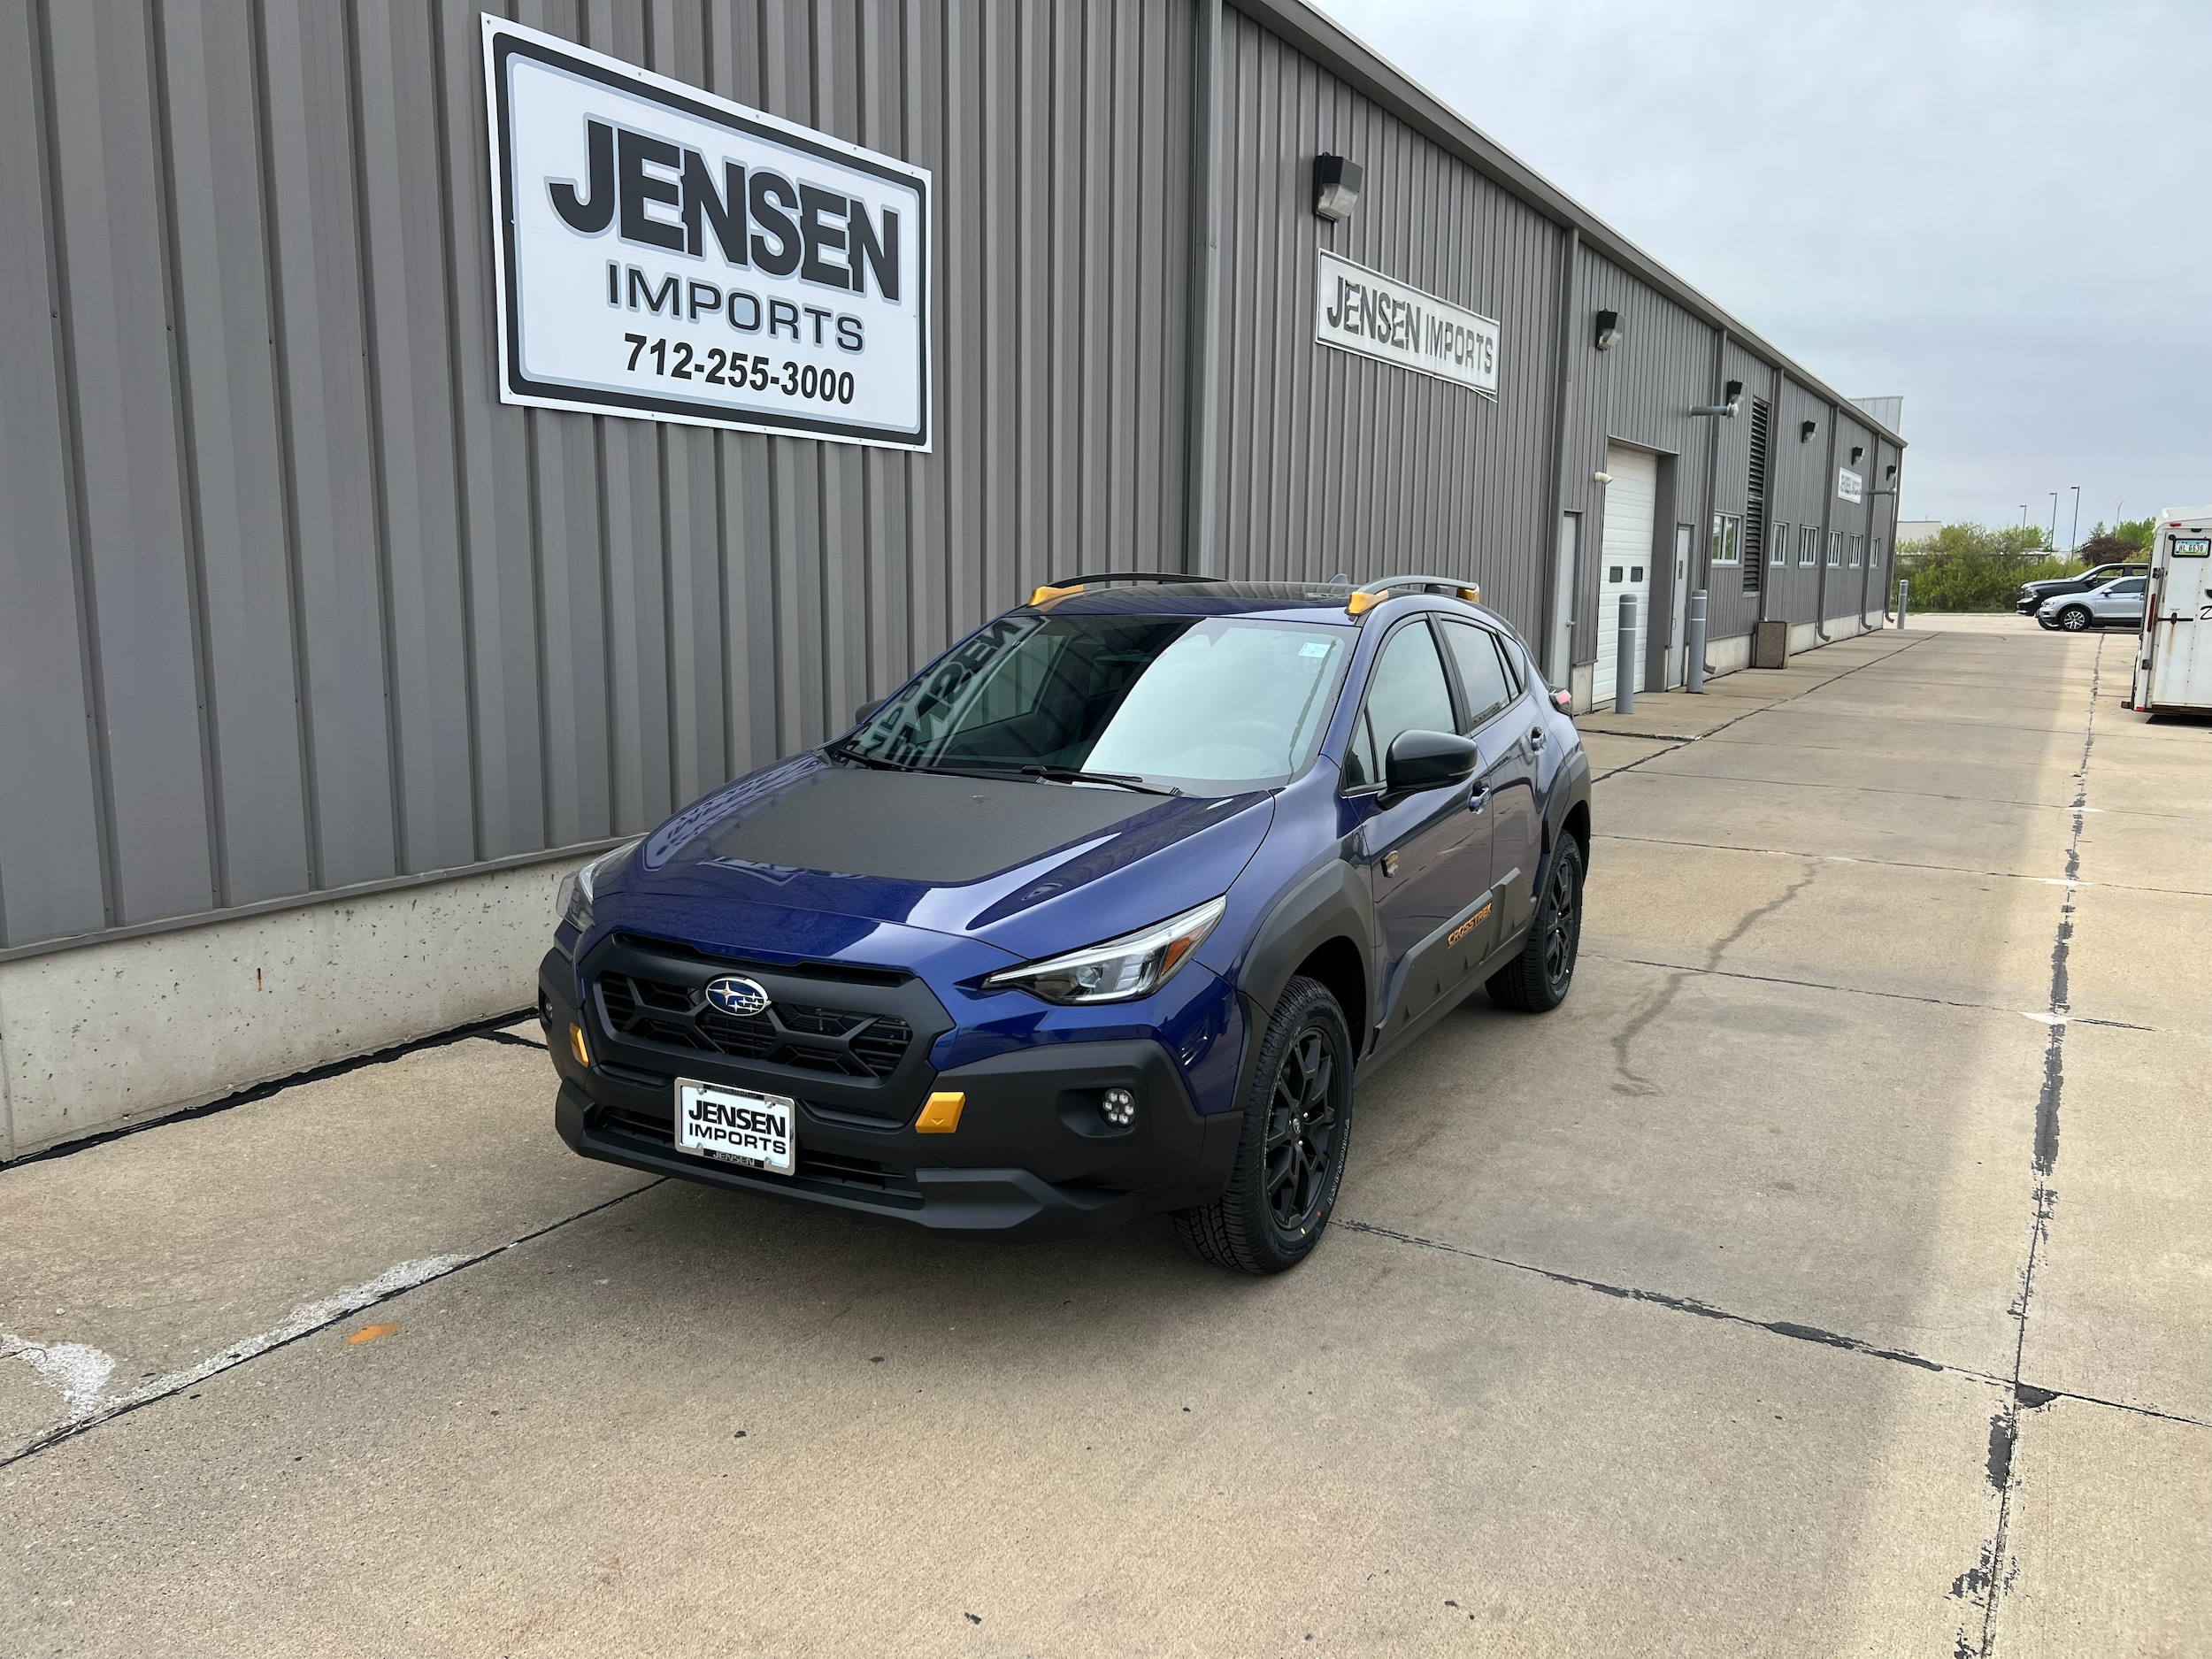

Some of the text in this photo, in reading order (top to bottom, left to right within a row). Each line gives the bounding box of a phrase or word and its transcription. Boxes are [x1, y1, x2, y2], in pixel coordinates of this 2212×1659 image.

[547, 115, 901, 303] JENSEN
[608, 262, 864, 353] IMPORTS
[1327, 275, 1494, 374] JENSEN IMPORTS
[624, 333, 855, 404] 712-255-3000
[1448, 902, 1493, 946] CROSSTREK
[688, 1100, 786, 1138] JENSEN
[688, 1123, 787, 1155] IMPORTS
[712, 1151, 756, 1166] JENSEN
